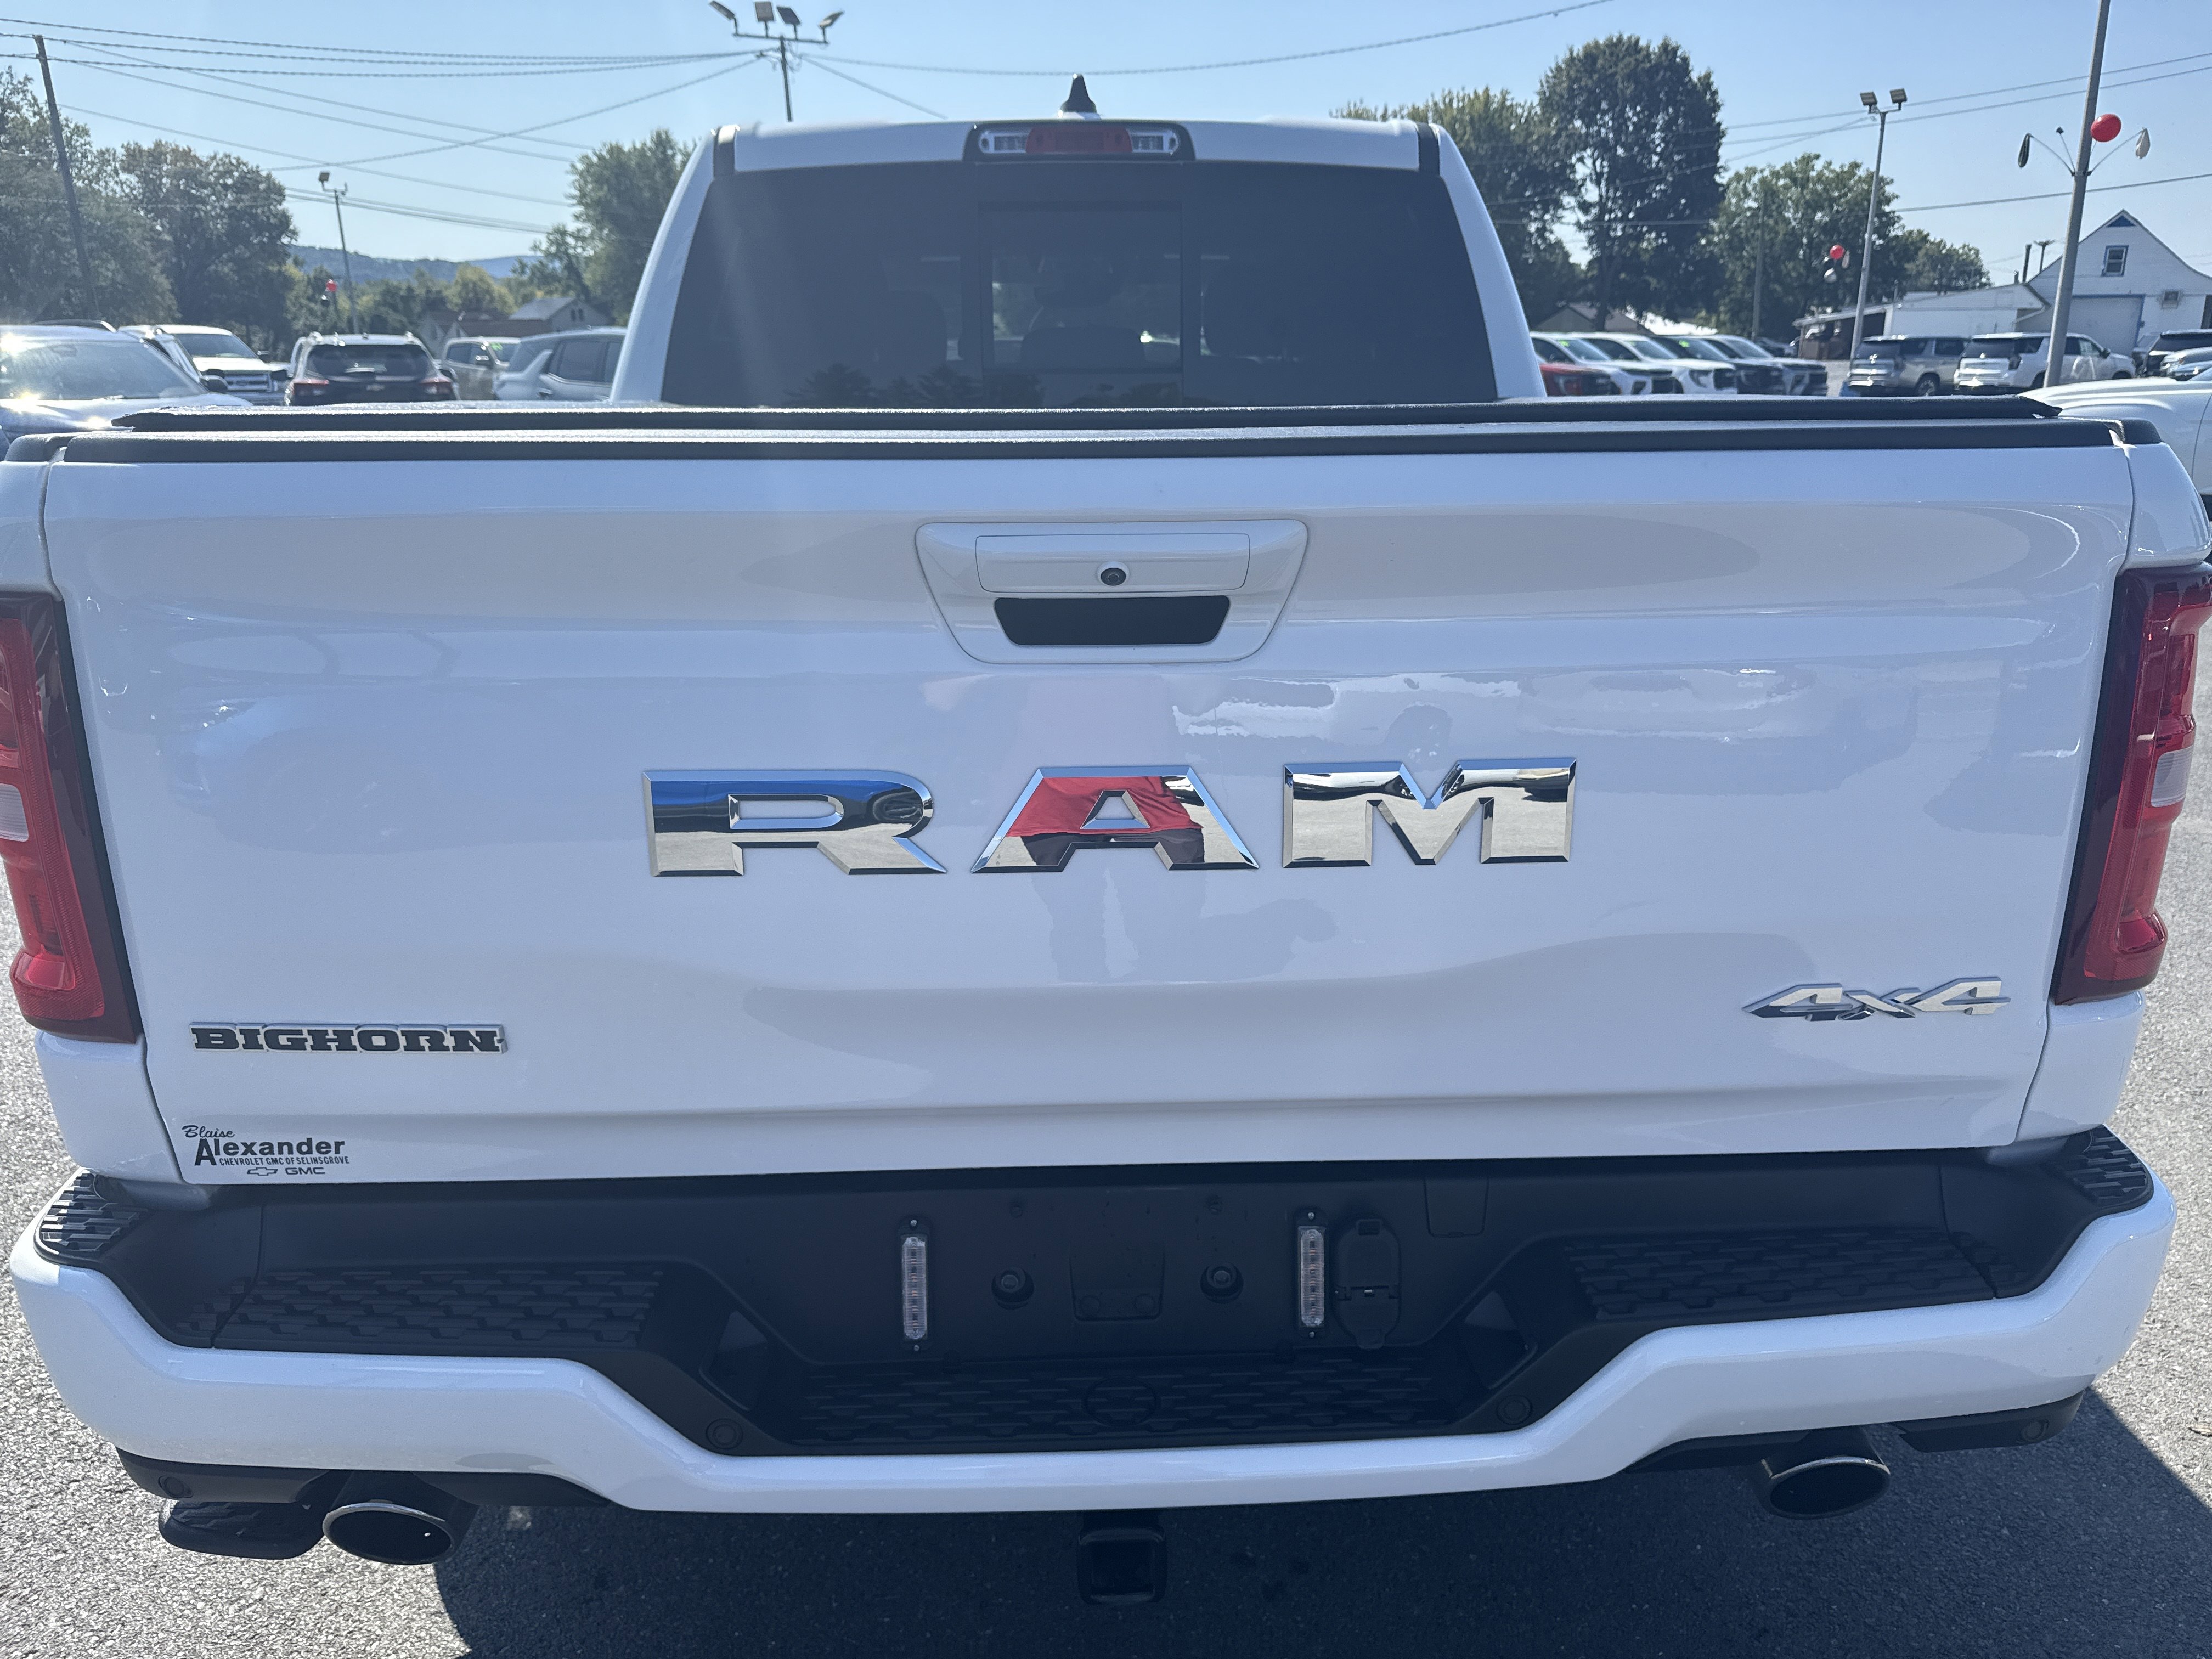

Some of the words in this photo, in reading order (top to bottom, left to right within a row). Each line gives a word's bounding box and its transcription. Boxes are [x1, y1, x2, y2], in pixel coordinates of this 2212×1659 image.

[642, 757, 1576, 877] RAM
[1741, 977, 2011, 1021] 4x4
[189, 1023, 505, 1053] BIGHORN
[182, 1125, 235, 1138] Blaise
[194, 1137, 345, 1166] Alexander
[296, 1156, 350, 1164] SELINSGROVE
[285, 1167, 325, 1175] GMC
